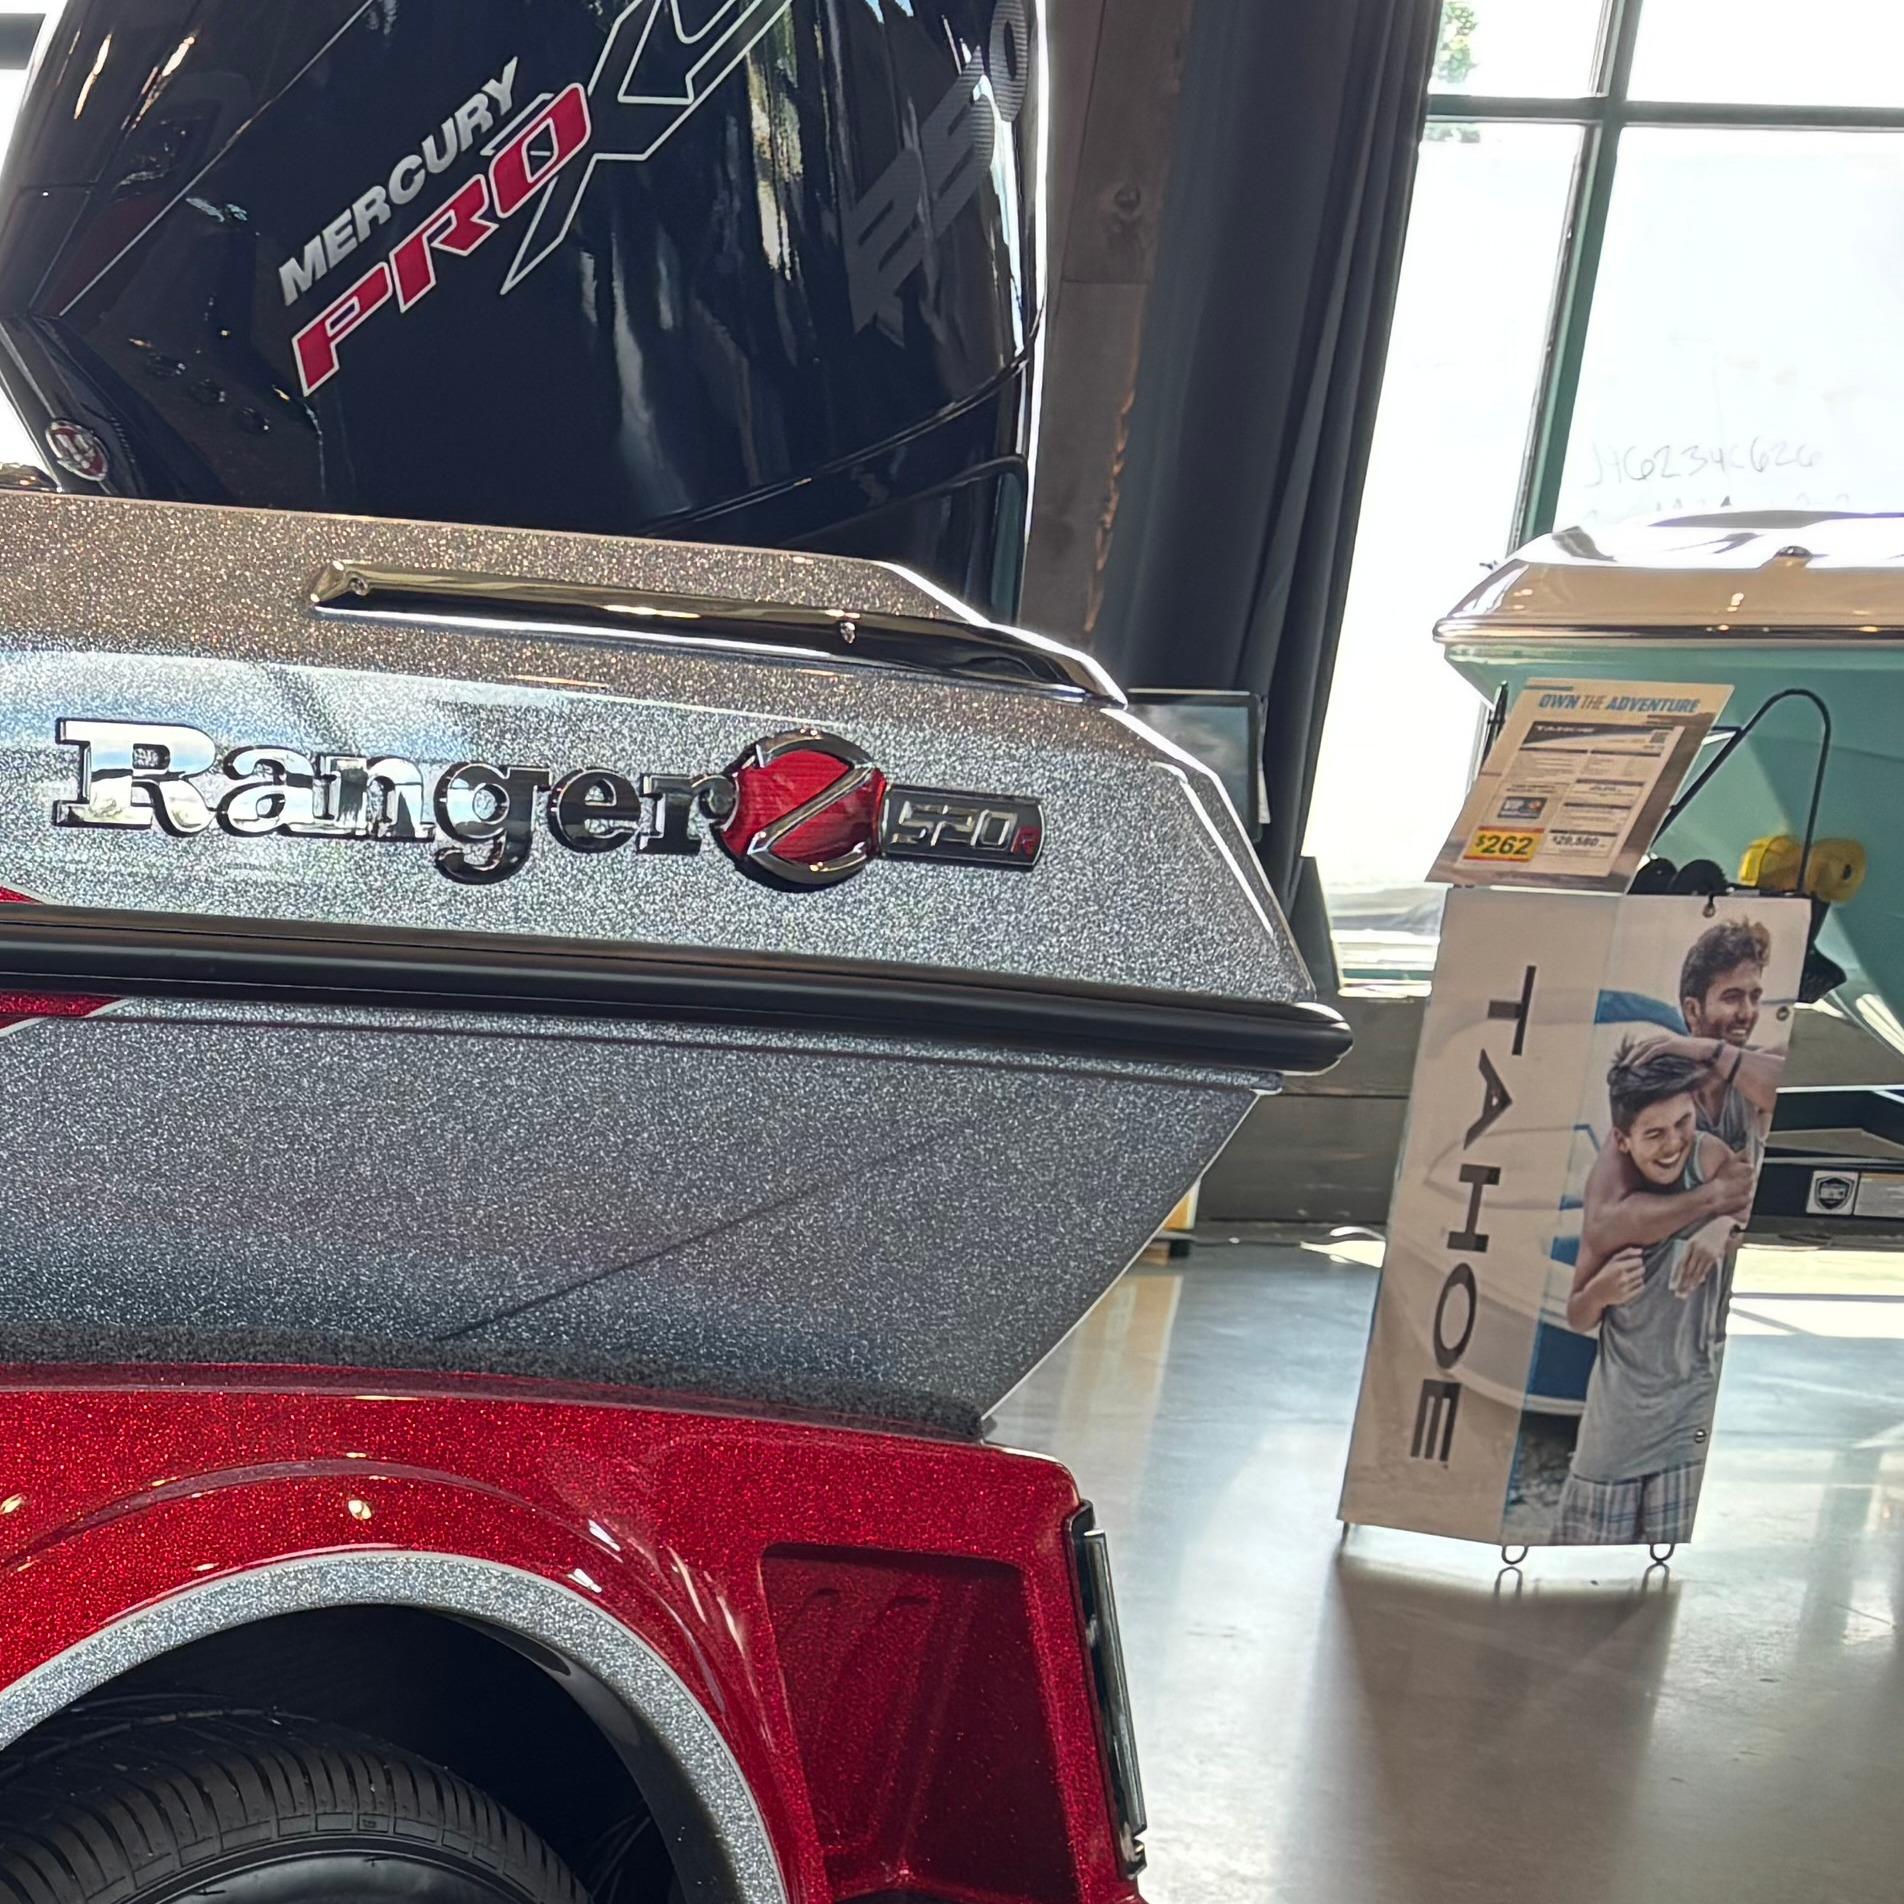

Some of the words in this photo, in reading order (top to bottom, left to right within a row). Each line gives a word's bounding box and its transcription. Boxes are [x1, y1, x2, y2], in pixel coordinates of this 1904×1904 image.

[278, 56, 518, 306] MERCURY
[292, 82, 591, 397] PRO
[54, 718, 738, 884] Ranger
[1538, 693, 1580, 709] OWN
[1580, 694, 1607, 711] THE
[1605, 695, 1701, 713] ADVENTURE
[1475, 834, 1534, 856] $262
[1410, 965, 1536, 1470] TAHOE
